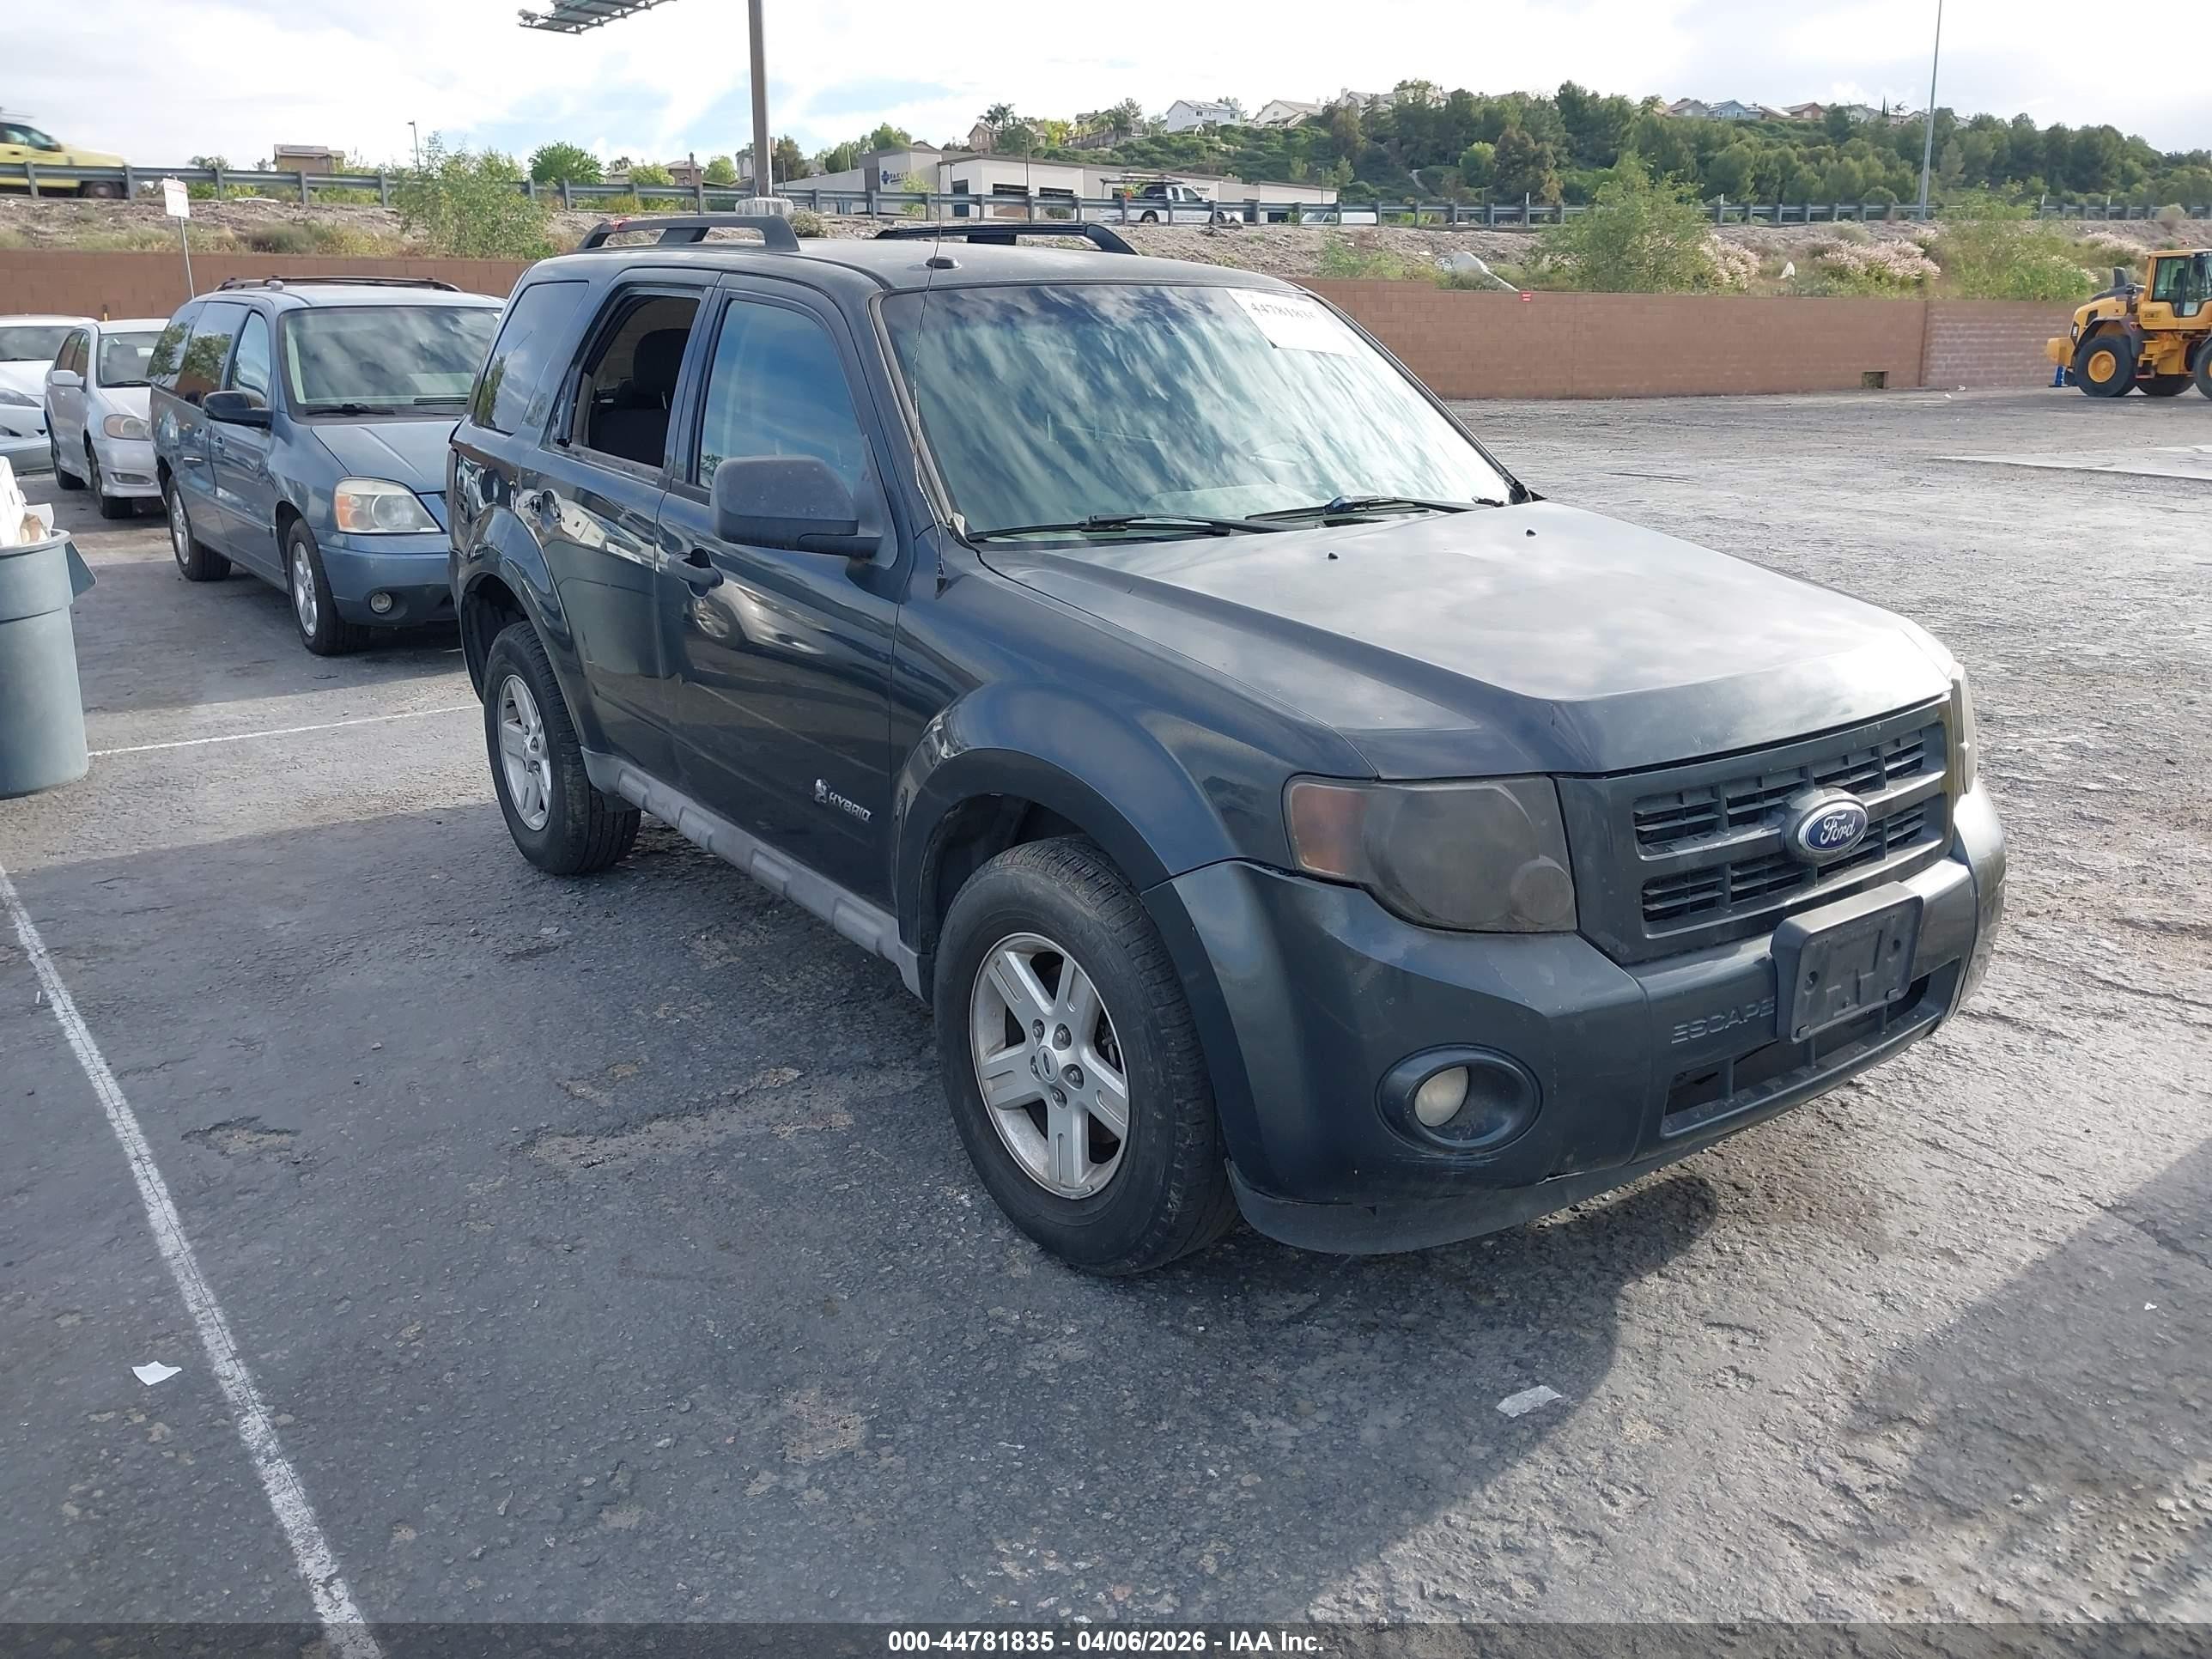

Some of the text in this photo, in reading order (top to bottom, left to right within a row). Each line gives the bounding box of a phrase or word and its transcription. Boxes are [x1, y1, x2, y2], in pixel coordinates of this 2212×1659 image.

[829, 792, 872, 823] HYBRID
[1820, 812, 1856, 845] Ford
[1671, 996, 1775, 1044] ESCAPE
